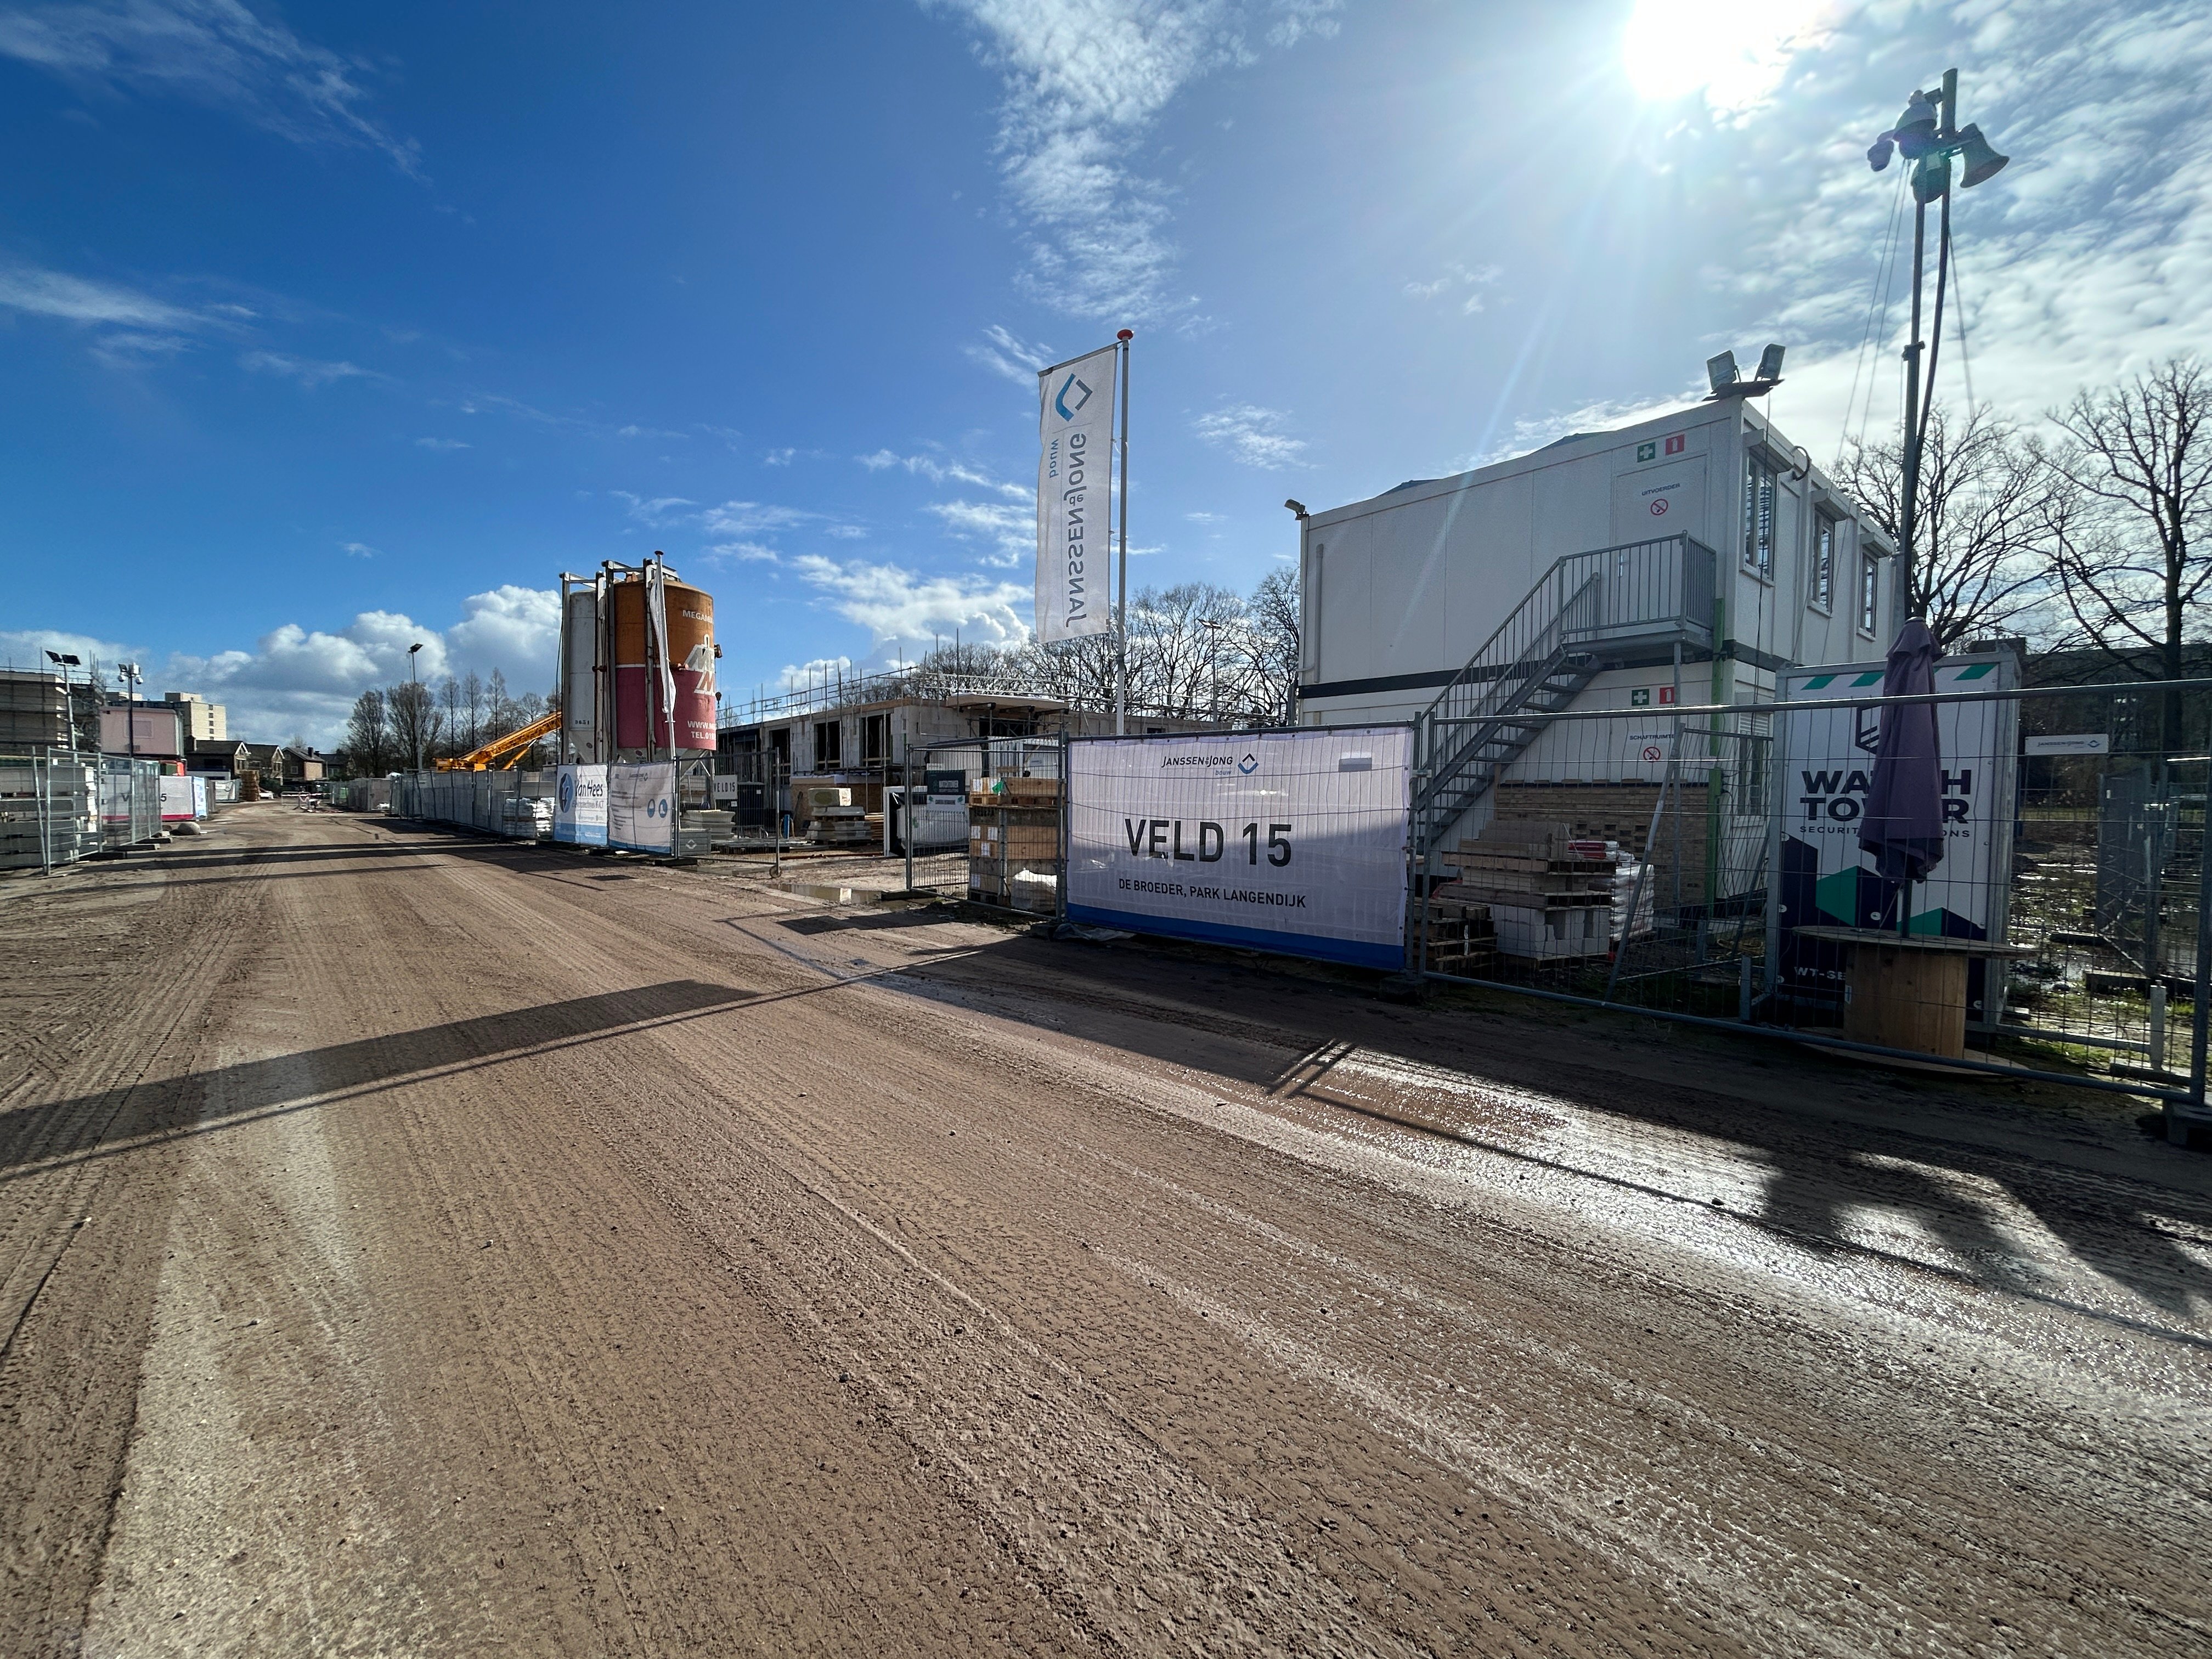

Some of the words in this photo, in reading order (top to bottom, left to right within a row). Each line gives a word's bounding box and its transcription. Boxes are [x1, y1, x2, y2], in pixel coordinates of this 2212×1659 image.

[1641, 483, 1680, 496] UITVOERDER
[714, 782, 728, 792] VELD
[730, 782, 735, 792] 15
[1801, 769, 1972, 795] WAH
[1800, 797, 1970, 824] TOR
[1124, 818, 1224, 863] VELD
[1243, 823, 1292, 867] 15
[1800, 826, 1859, 834] SECURIT
[1119, 878, 1132, 890] DE
[1133, 881, 1187, 898] BROEDER,
[1189, 885, 1221, 900] PARK
[1223, 889, 1306, 908] LANGENDIJK
